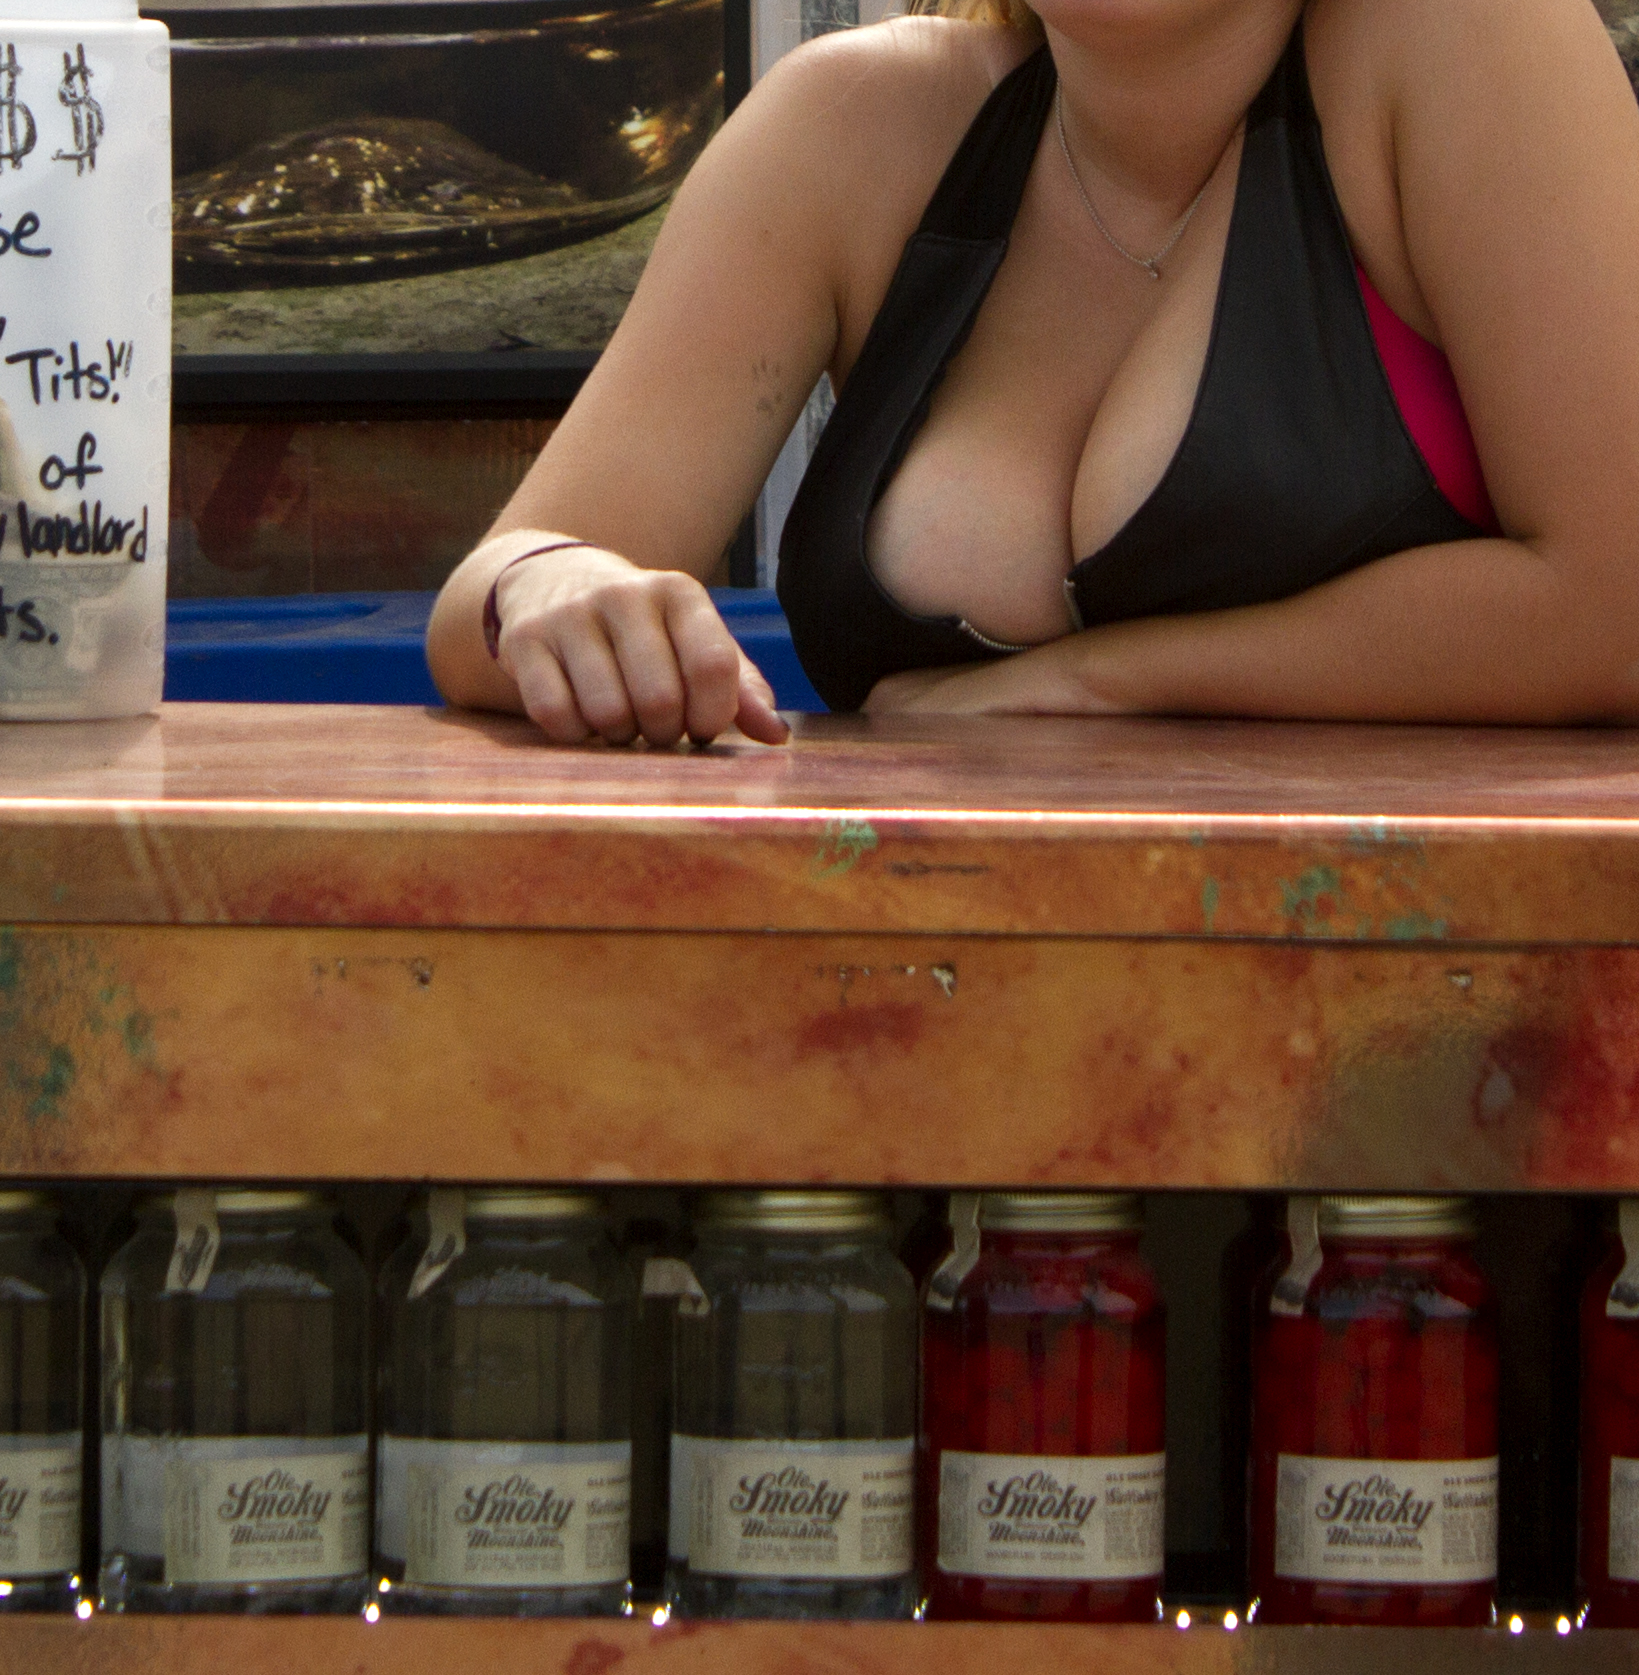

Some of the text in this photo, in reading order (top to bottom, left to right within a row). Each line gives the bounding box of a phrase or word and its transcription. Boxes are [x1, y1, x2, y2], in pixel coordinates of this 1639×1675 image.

[38, 430, 104, 490] of
[16, 498, 149, 565] landlord
[218, 1476, 332, 1525] Smoky
[454, 1481, 576, 1532] Smoky
[729, 1472, 850, 1524] Smoky
[978, 1476, 1097, 1529] Smoky
[1315, 1480, 1435, 1533] Smoky
